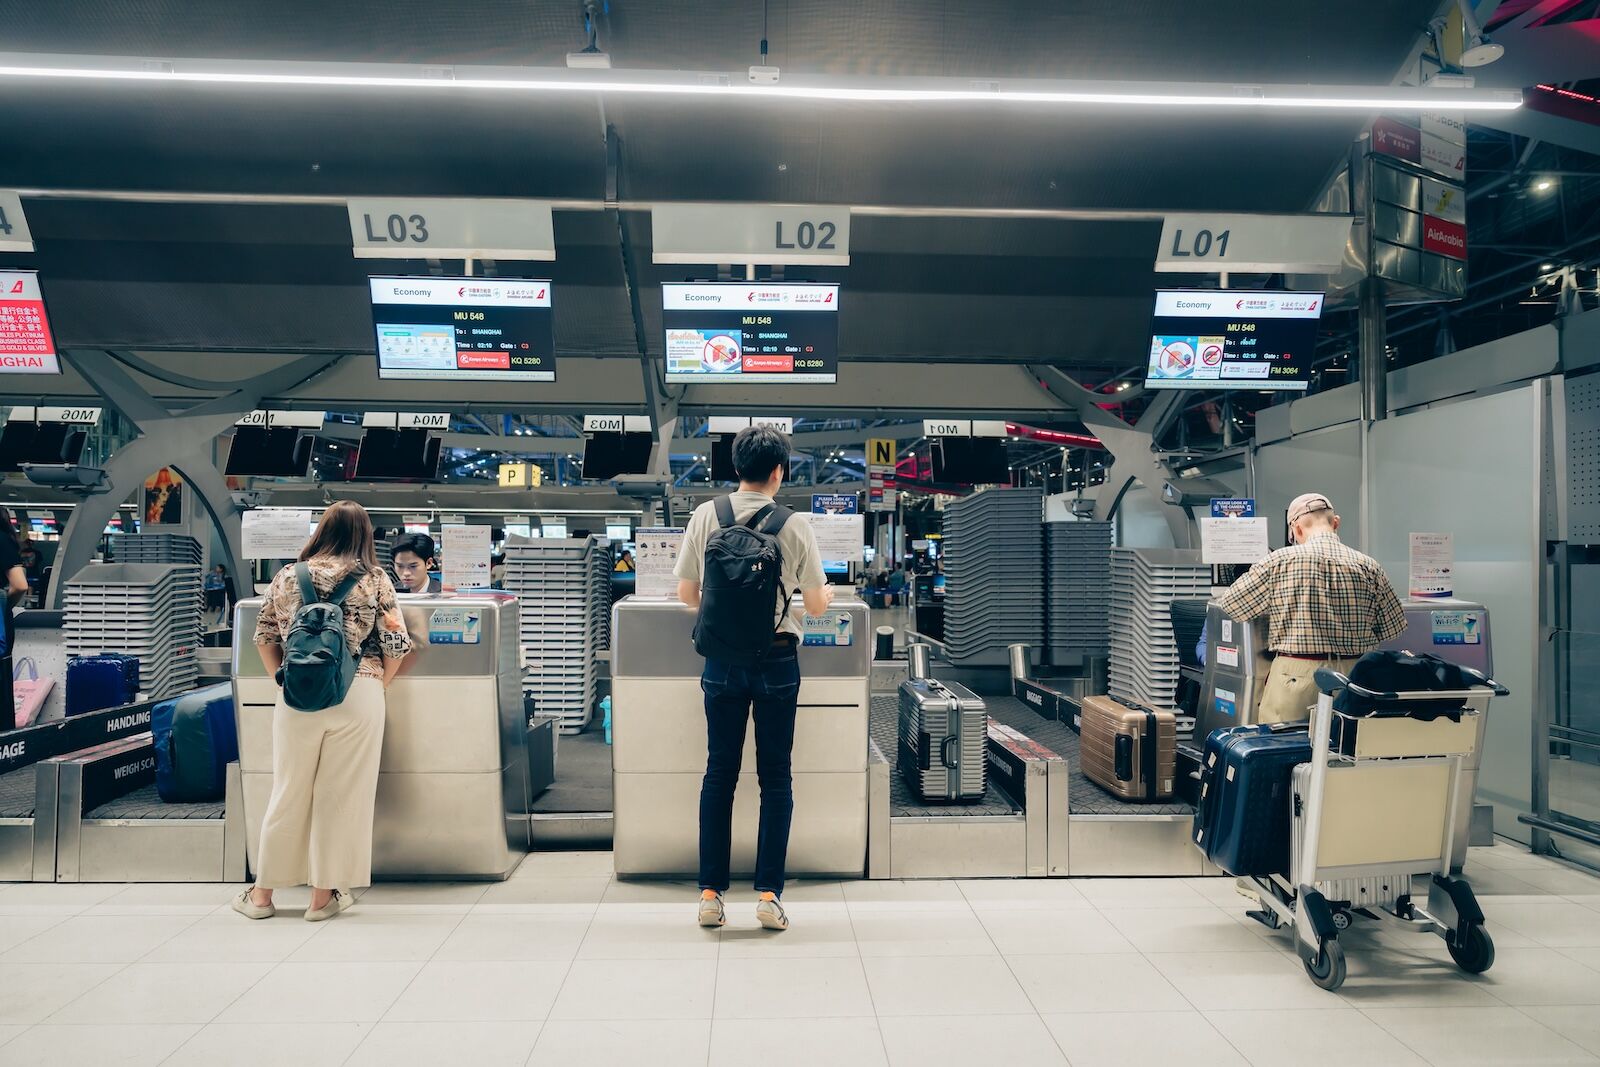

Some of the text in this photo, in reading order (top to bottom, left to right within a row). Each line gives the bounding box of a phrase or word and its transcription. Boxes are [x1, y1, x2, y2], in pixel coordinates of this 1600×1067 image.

[0, 206, 12, 234] 4
[364, 214, 428, 242] L03
[776, 222, 836, 249] L02
[1172, 230, 1230, 256] L01
[394, 288, 432, 298] Economy
[684, 293, 722, 302] Economy
[454, 312, 485, 320] MU 548
[1176, 301, 1212, 310] Economy
[877, 442, 890, 463] N
[509, 470, 516, 482] P
[107, 711, 151, 732] HANDLING
[0, 741, 25, 760] AGE
[114, 757, 155, 780] WEIGH SCA
